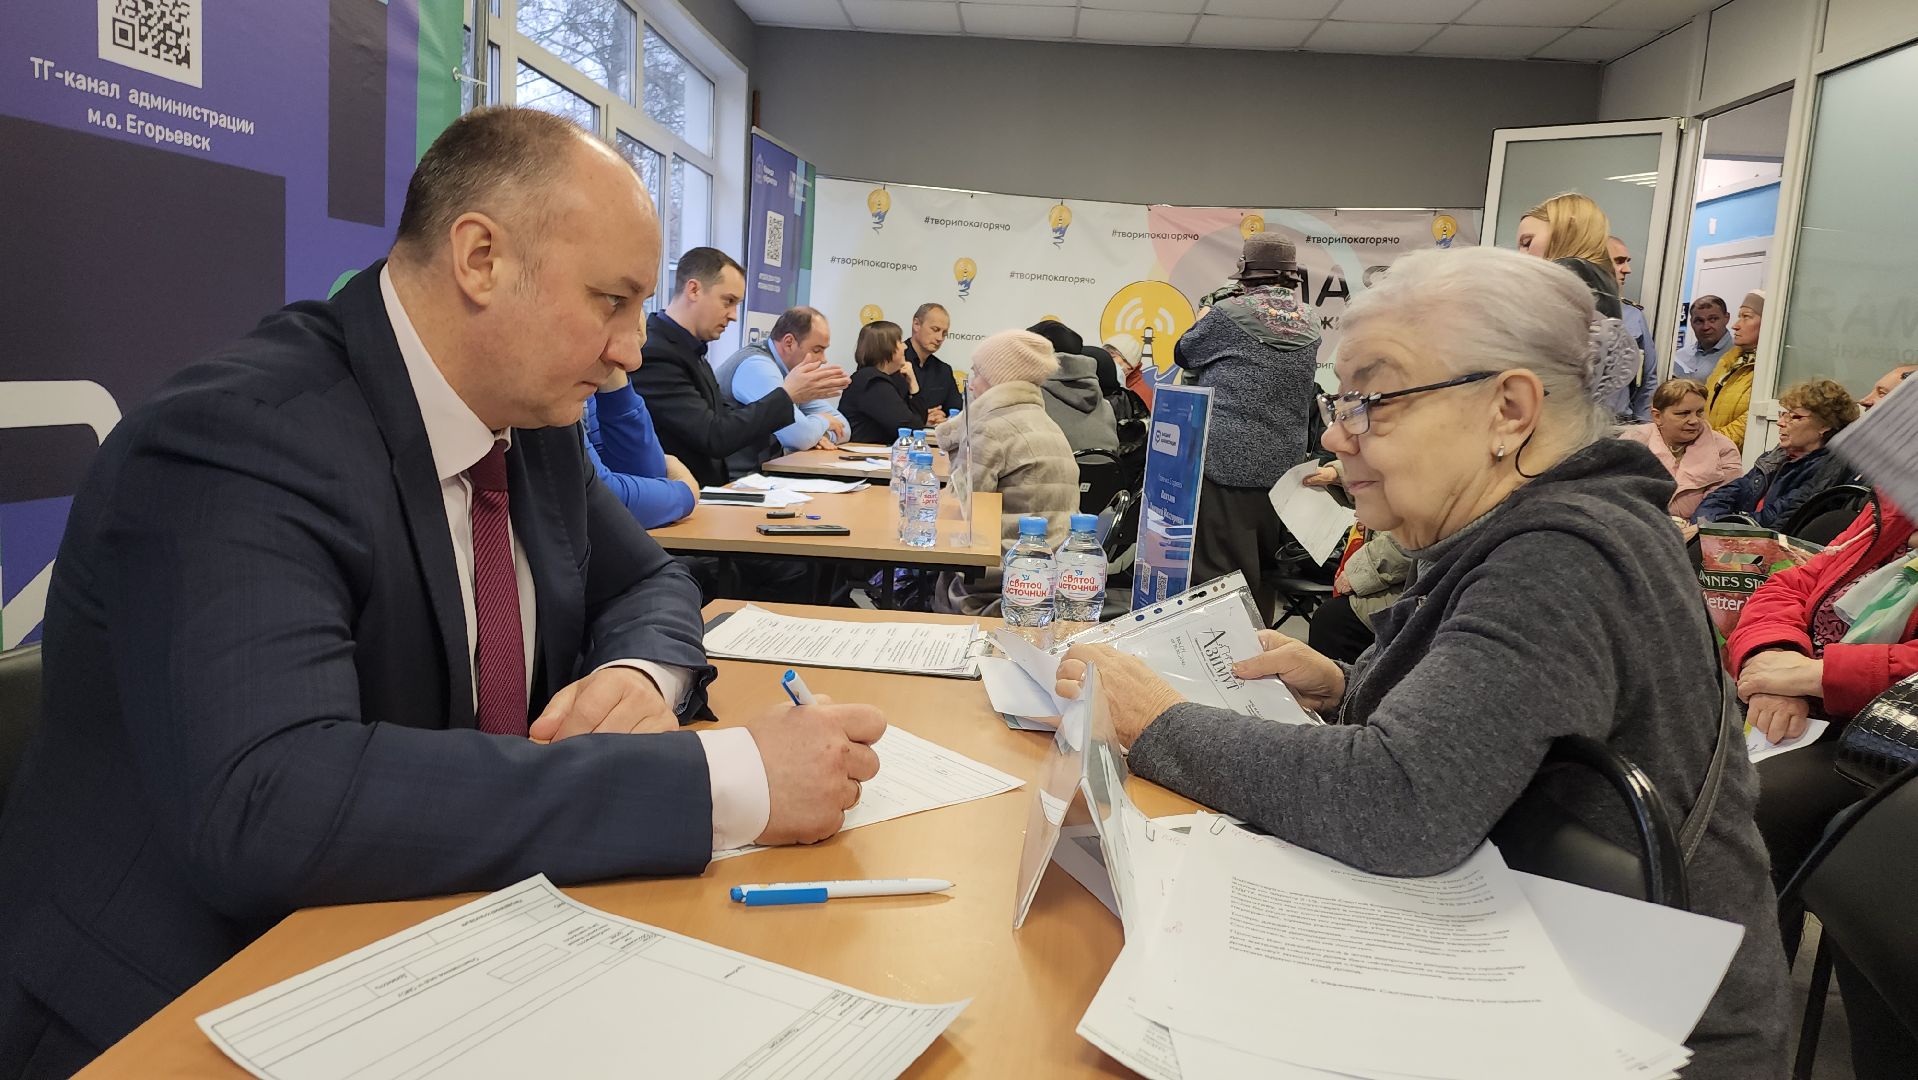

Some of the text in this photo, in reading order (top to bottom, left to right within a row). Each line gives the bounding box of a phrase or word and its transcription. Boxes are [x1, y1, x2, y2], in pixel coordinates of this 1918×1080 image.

[30, 57, 255, 136] ТГ-канал администрации
[126, 114, 211, 152] Егорьевск
[924, 215, 1011, 232] #творипокагорячо
[1111, 229, 1200, 242] #творипокагорячо
[1305, 235, 1400, 246] #творипокагорячо
[830, 255, 918, 273] #творипокагорячо
[1009, 271, 1096, 286] #творипокагорячо
